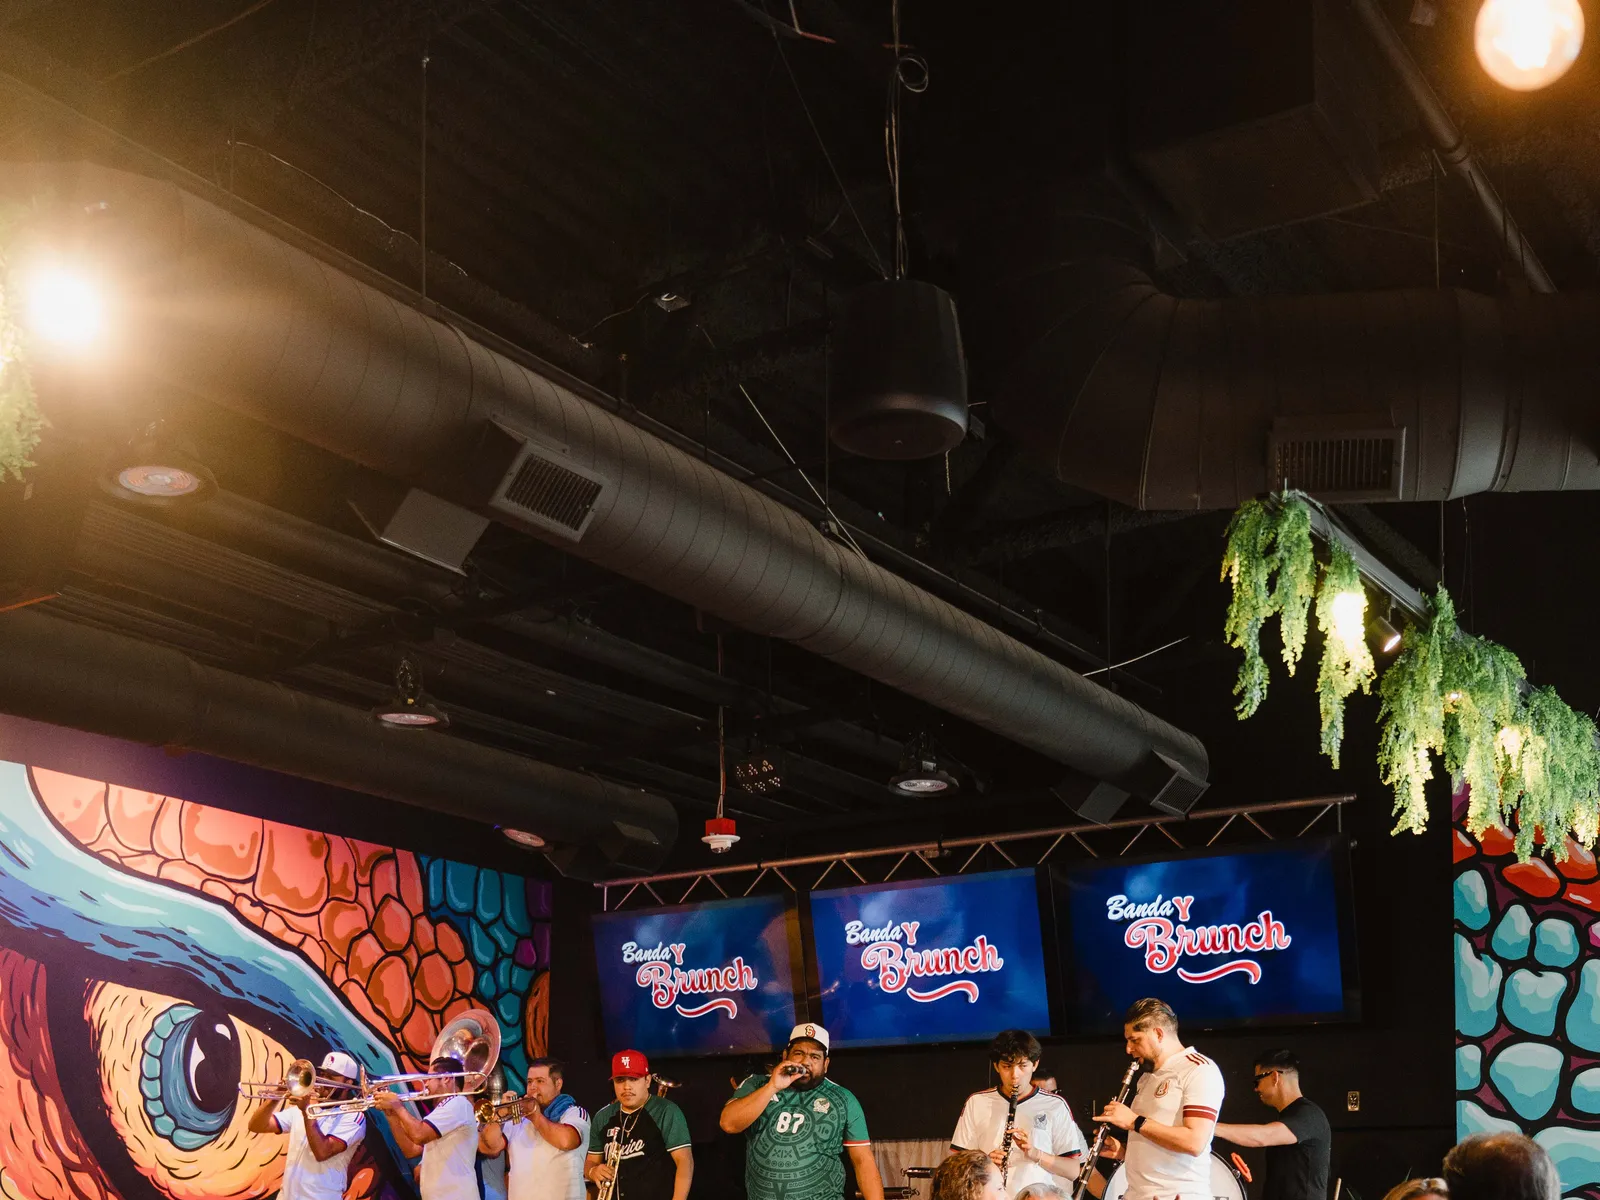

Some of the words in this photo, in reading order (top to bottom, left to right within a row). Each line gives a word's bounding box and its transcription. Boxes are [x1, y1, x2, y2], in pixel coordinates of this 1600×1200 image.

[1106, 894, 1175, 920] Banda
[1172, 896, 1194, 922] Y
[845, 920, 902, 944] Banda
[901, 921, 920, 945] Y
[1124, 910, 1291, 974] Brunch
[622, 941, 672, 963] Banda
[670, 943, 686, 965] Y
[861, 935, 1004, 993] Brunch
[636, 956, 758, 1009] Brunch
[776, 1111, 805, 1134] 87
